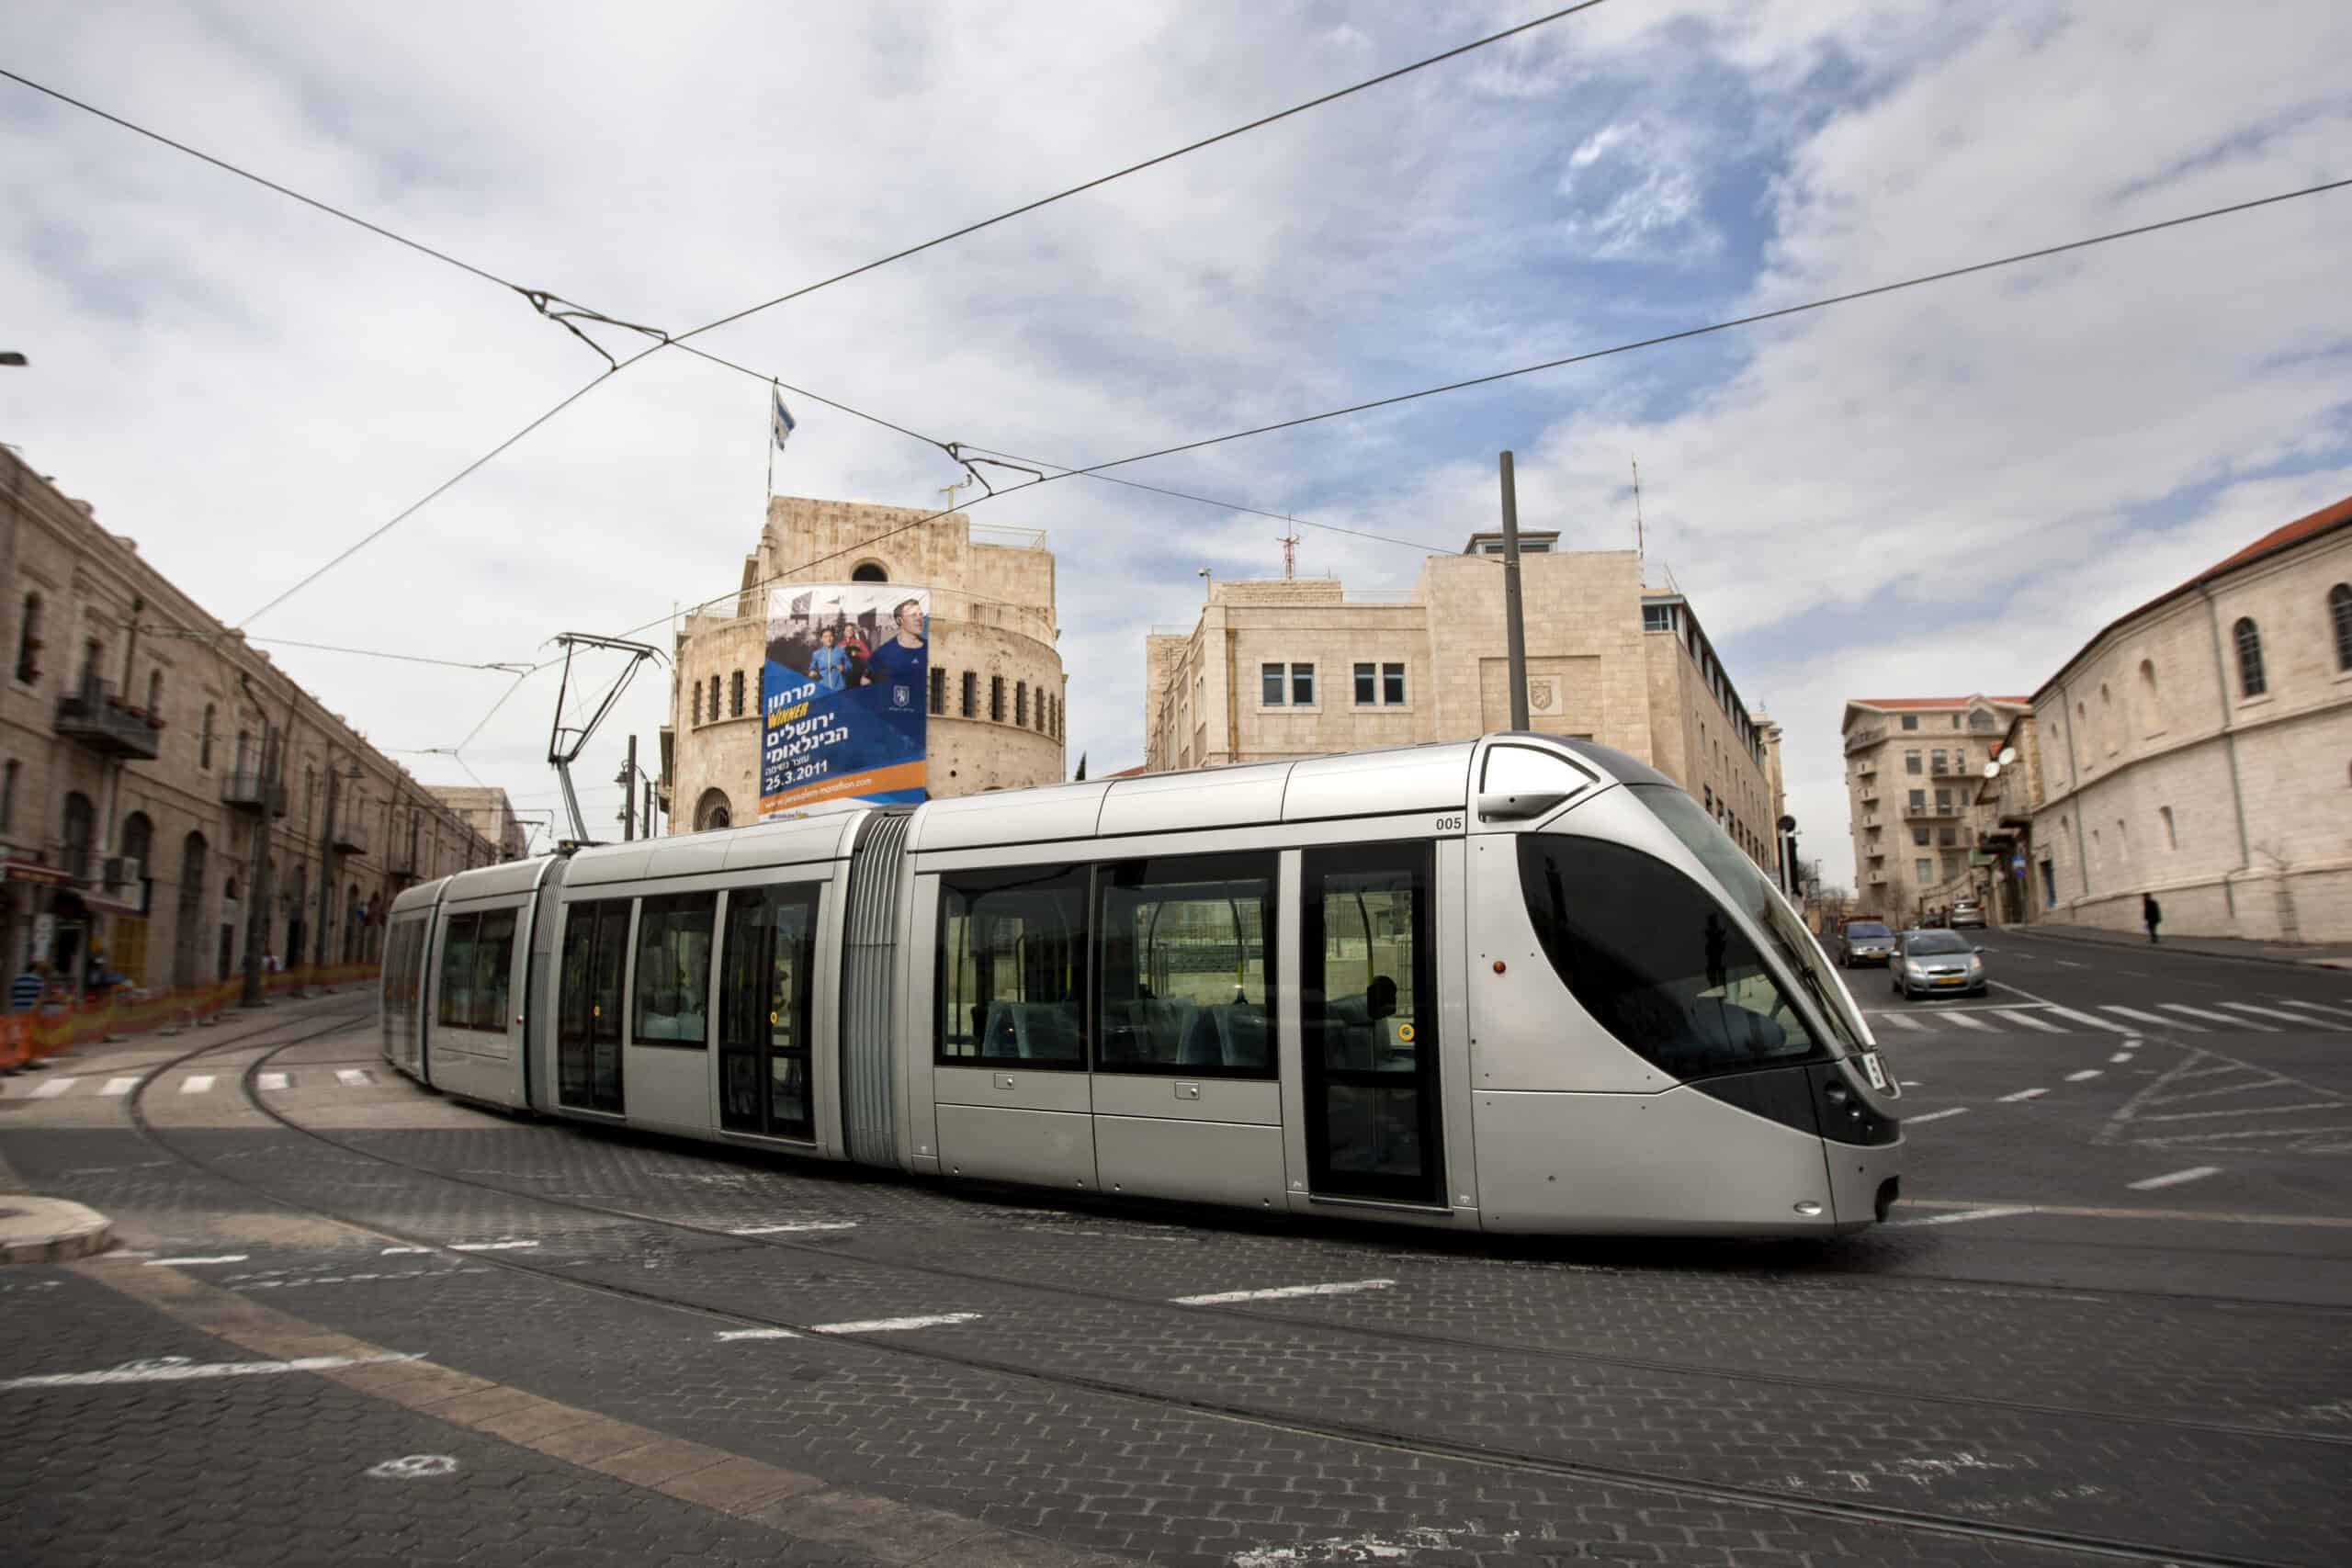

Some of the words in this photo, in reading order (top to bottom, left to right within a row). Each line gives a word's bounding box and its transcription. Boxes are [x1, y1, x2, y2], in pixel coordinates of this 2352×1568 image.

[768, 682, 816, 711] מרתון
[766, 713, 834, 747] ירושלים
[768, 702, 808, 728] WINNER
[766, 727, 849, 763] הבינלאומי
[764, 760, 828, 791] 25.3.2011
[1436, 818, 1462, 830] 005
